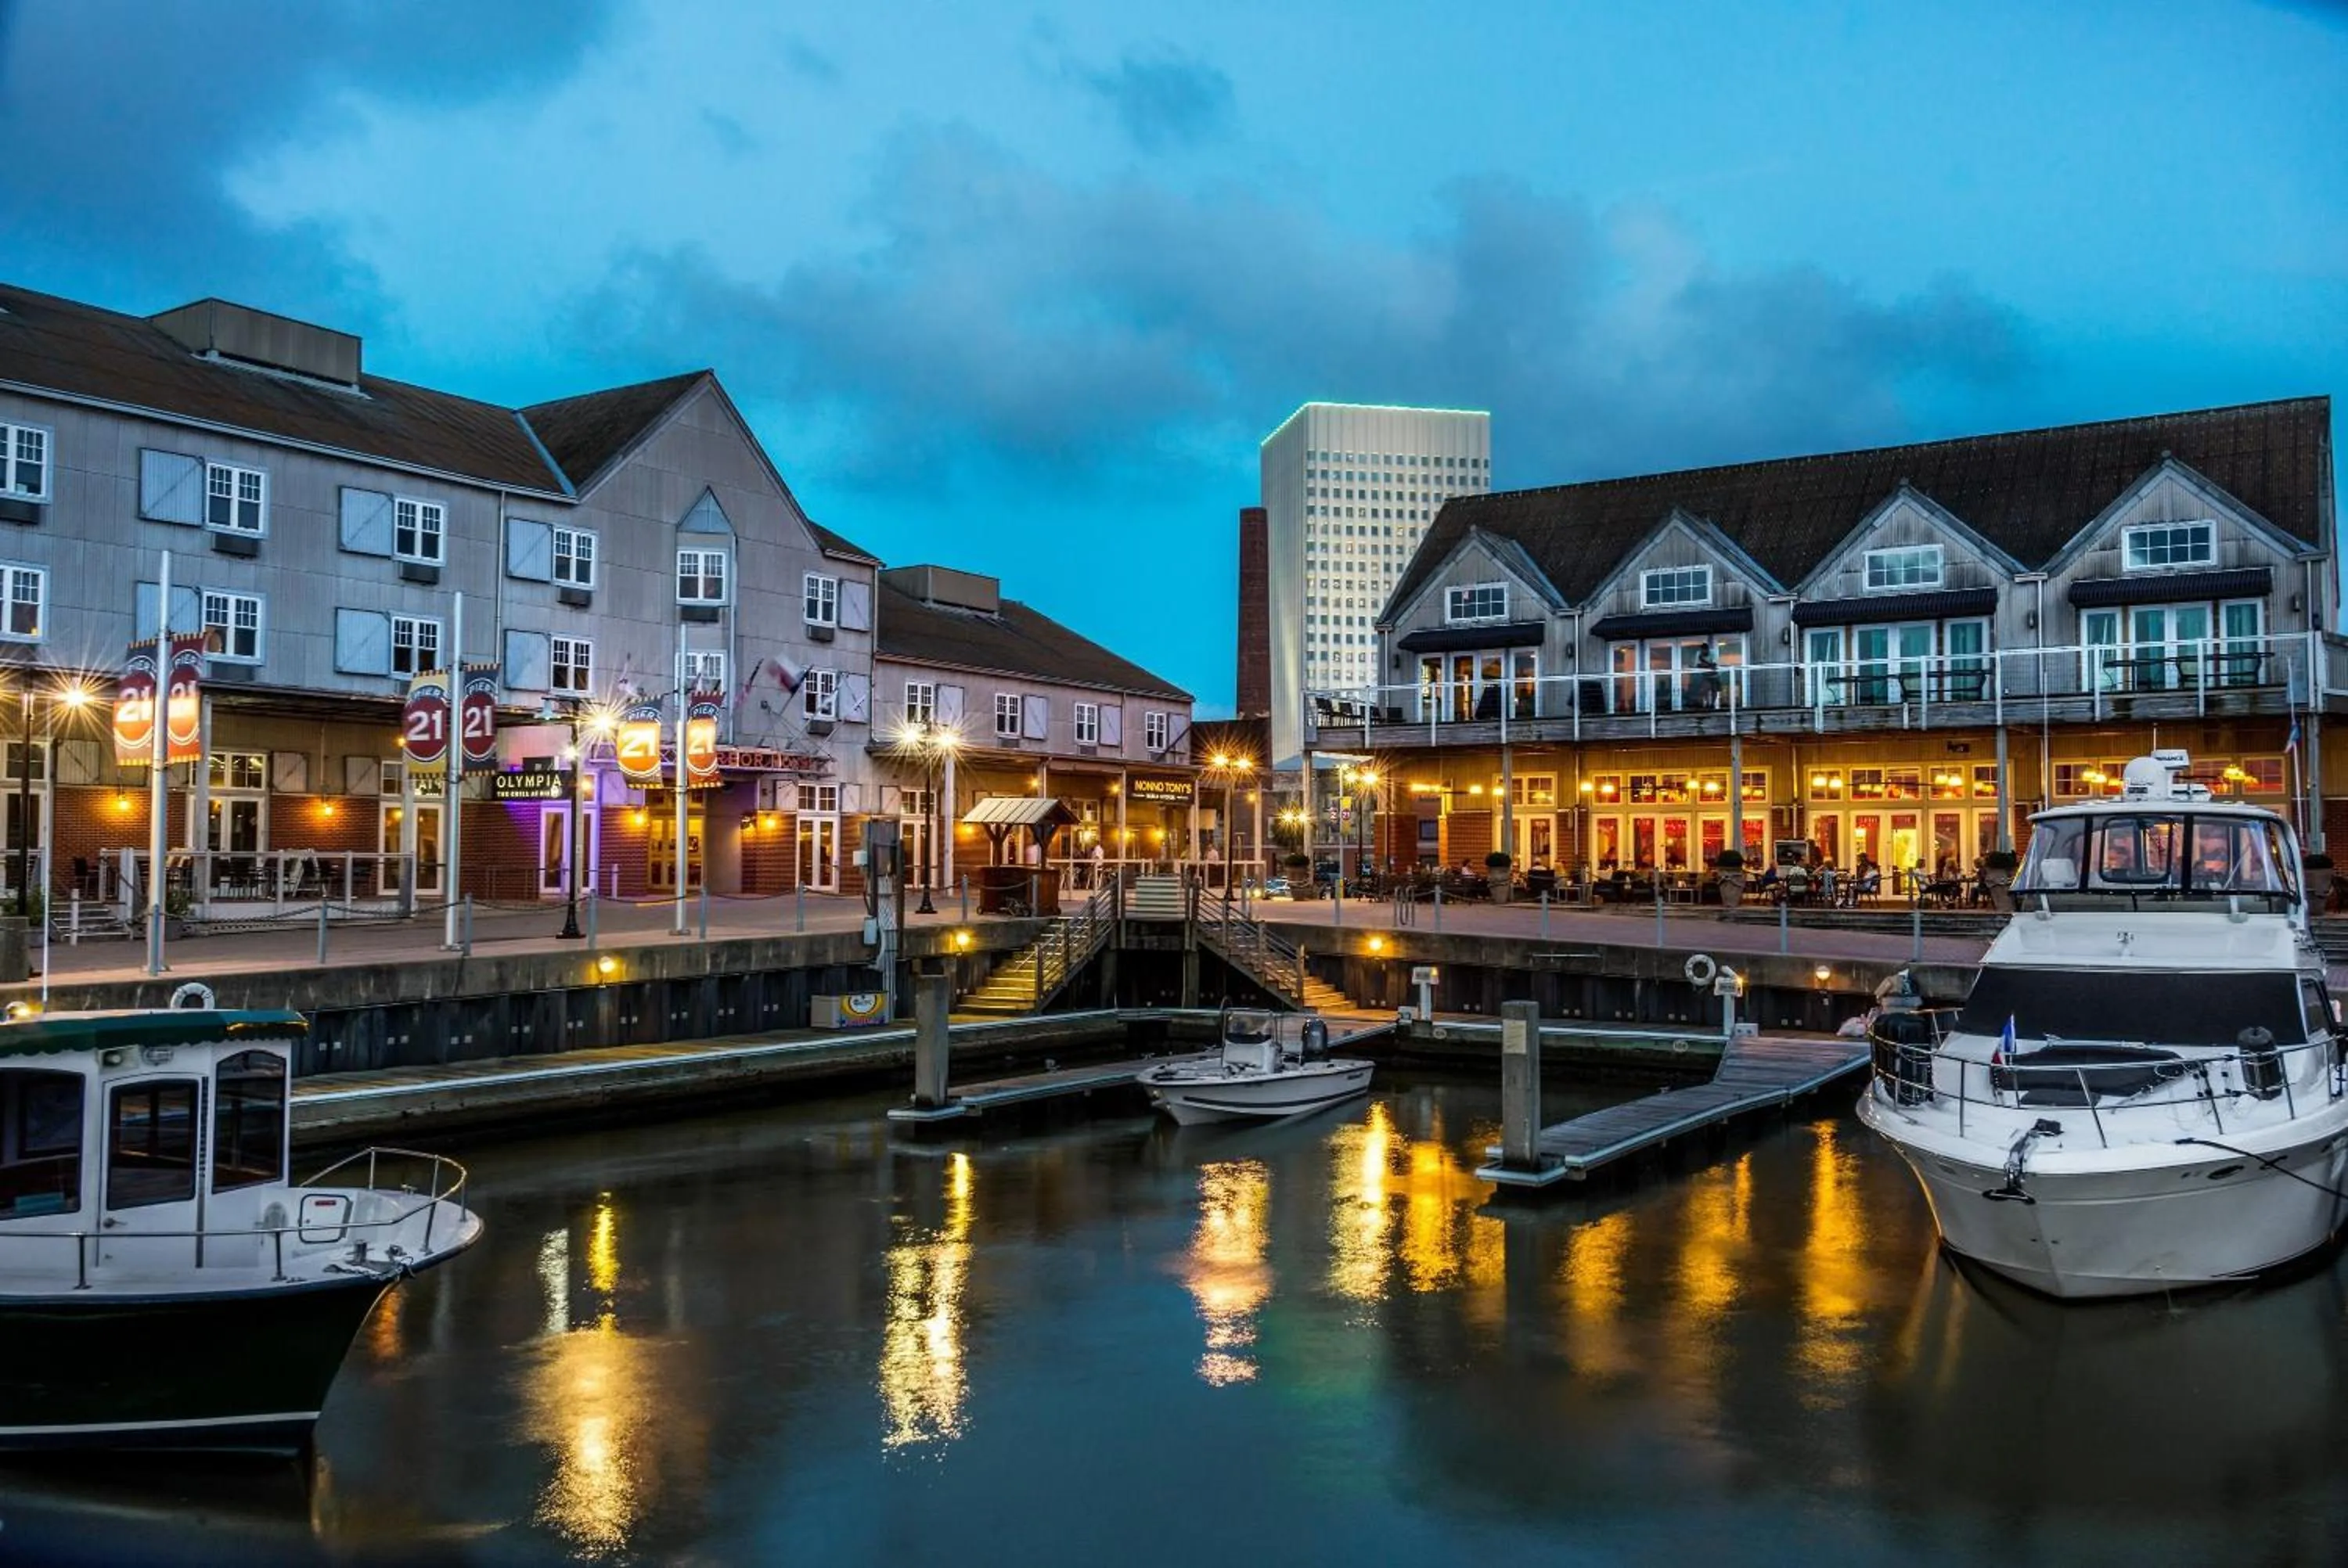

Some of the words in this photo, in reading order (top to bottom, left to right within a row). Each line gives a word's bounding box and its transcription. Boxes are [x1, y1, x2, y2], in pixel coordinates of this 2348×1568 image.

[117, 685, 153, 722] 21
[693, 706, 715, 717] PIER
[407, 710, 443, 741] 21
[464, 705, 493, 738] 21
[621, 729, 657, 757] 21
[688, 726, 715, 754] 21
[496, 774, 562, 789] OLYMPIA
[1135, 780, 1164, 792] NONNO
[1165, 782, 1192, 793] TONY'S
